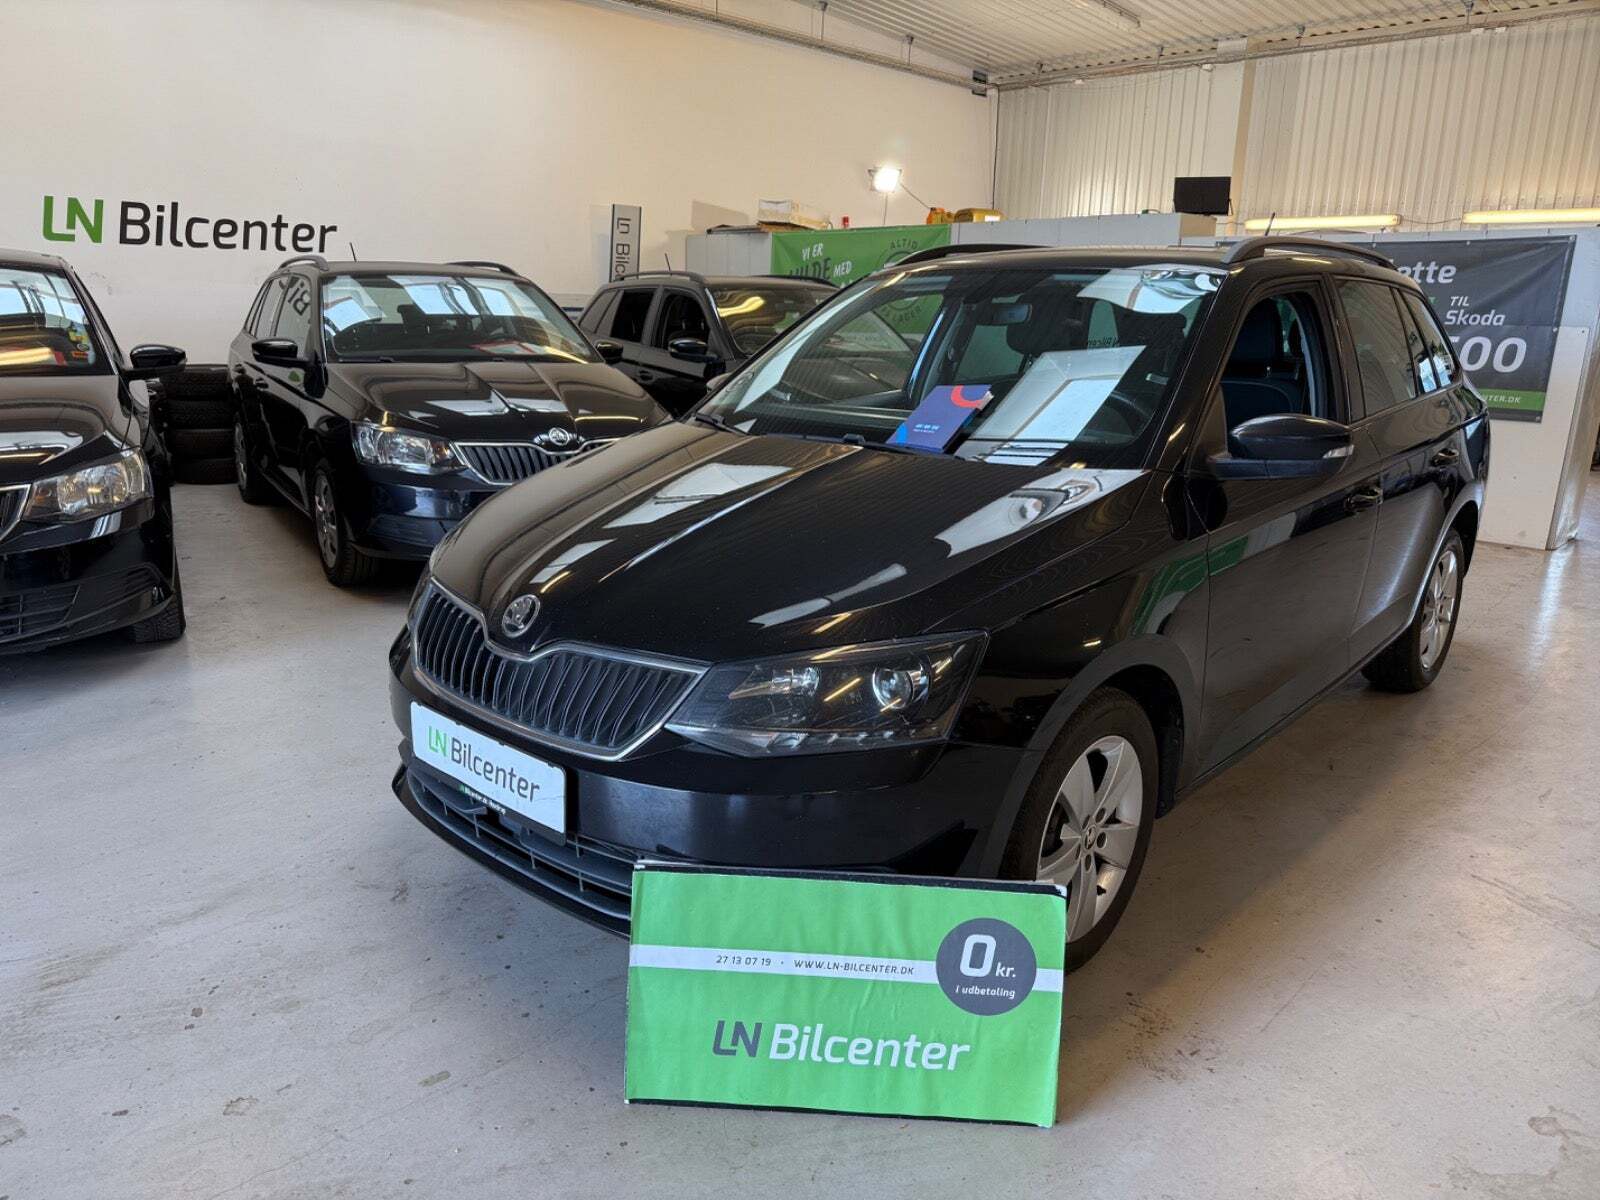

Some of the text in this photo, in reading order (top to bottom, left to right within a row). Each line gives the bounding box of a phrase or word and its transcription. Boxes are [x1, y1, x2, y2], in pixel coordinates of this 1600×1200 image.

[42, 195, 338, 253] LN Bilcenter
[812, 243, 824, 257] ER
[834, 261, 853, 278] MED
[1389, 259, 1457, 284] ette
[1450, 296, 1470, 307] TIL
[1444, 310, 1506, 327] Skoda
[428, 726, 448, 758] LN
[451, 737, 541, 803] Bilcenter
[716, 956, 914, 976] 27 13 07 19 WWW.LN-BILCENTER.DK
[960, 934, 1017, 978] 0 kr.
[962, 986, 1016, 999] udbetaling
[712, 1020, 971, 1072] LN Bilcenter
